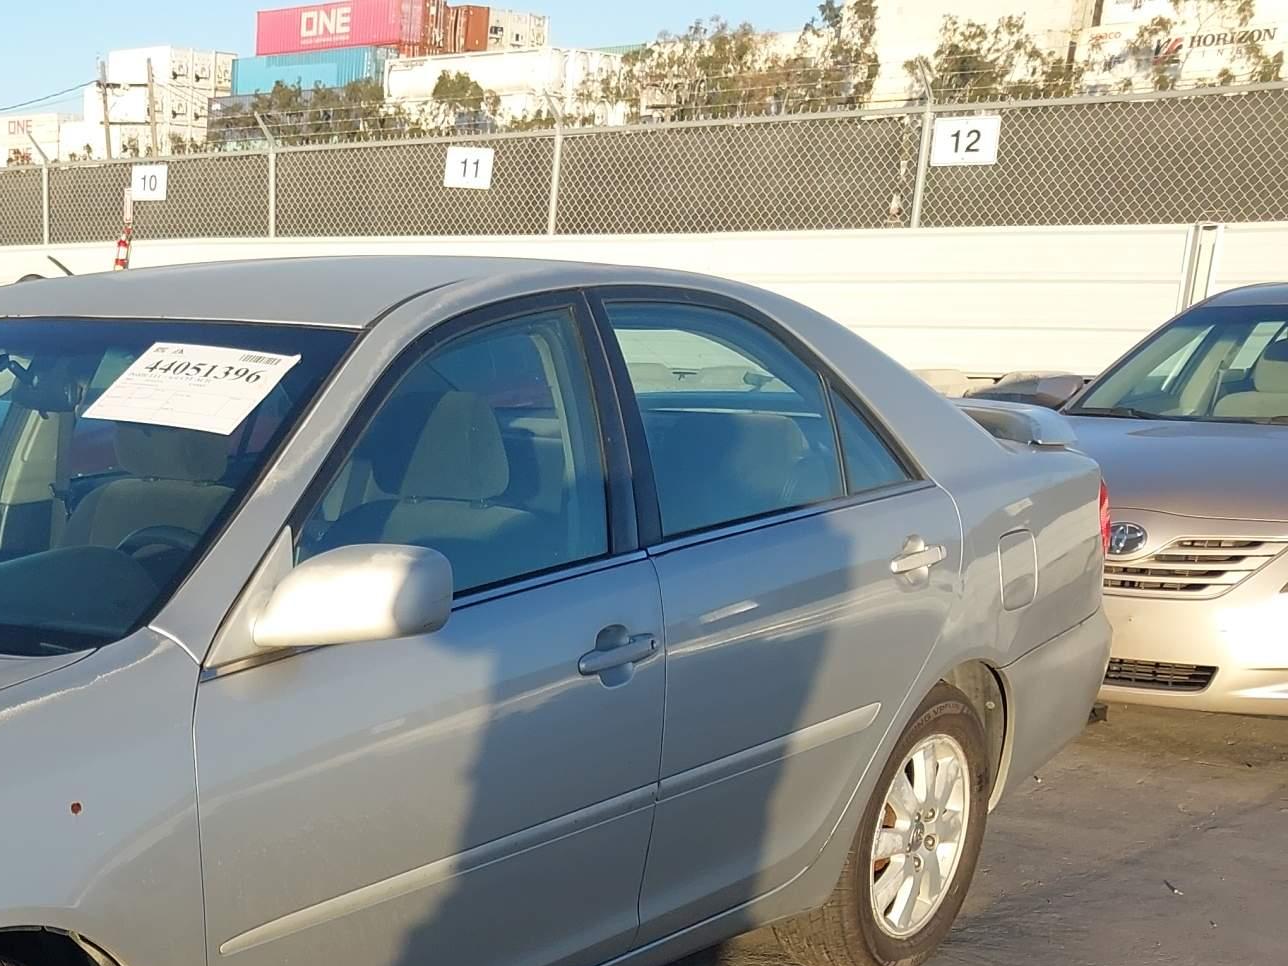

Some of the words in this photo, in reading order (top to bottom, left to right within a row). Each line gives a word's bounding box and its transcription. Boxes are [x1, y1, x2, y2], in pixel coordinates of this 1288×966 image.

[300, 7, 352, 37] ONE
[1189, 27, 1278, 49] HORIZON
[8, 119, 33, 135] ONE
[950, 129, 981, 153] 12
[460, 158, 479, 178] 11
[140, 174, 158, 192] 10
[144, 359, 266, 384] 44051396
